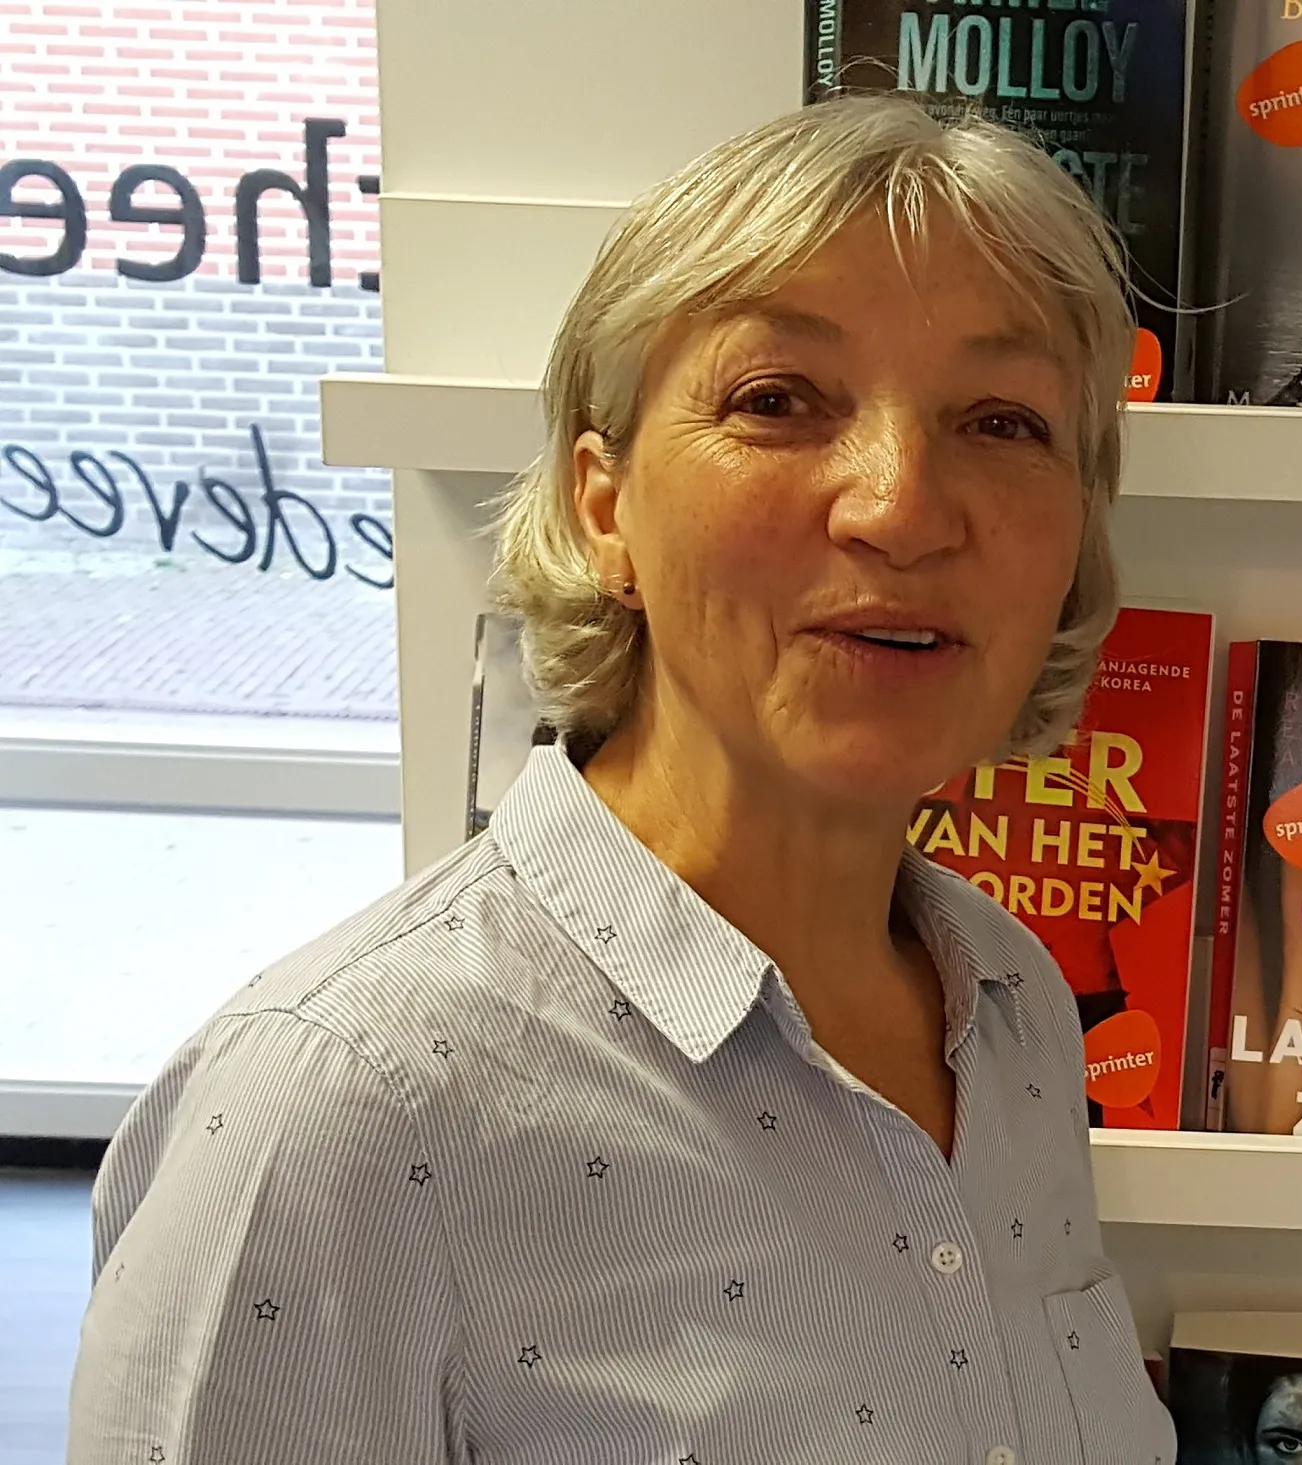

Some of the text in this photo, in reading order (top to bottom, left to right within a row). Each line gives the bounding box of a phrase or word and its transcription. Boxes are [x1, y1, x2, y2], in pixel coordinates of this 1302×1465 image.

[898, 12, 1138, 102] MOLLOY
[906, 808, 1147, 871] VAN HET
[1219, 690, 1244, 936] DE LAATSTE ZOMER
